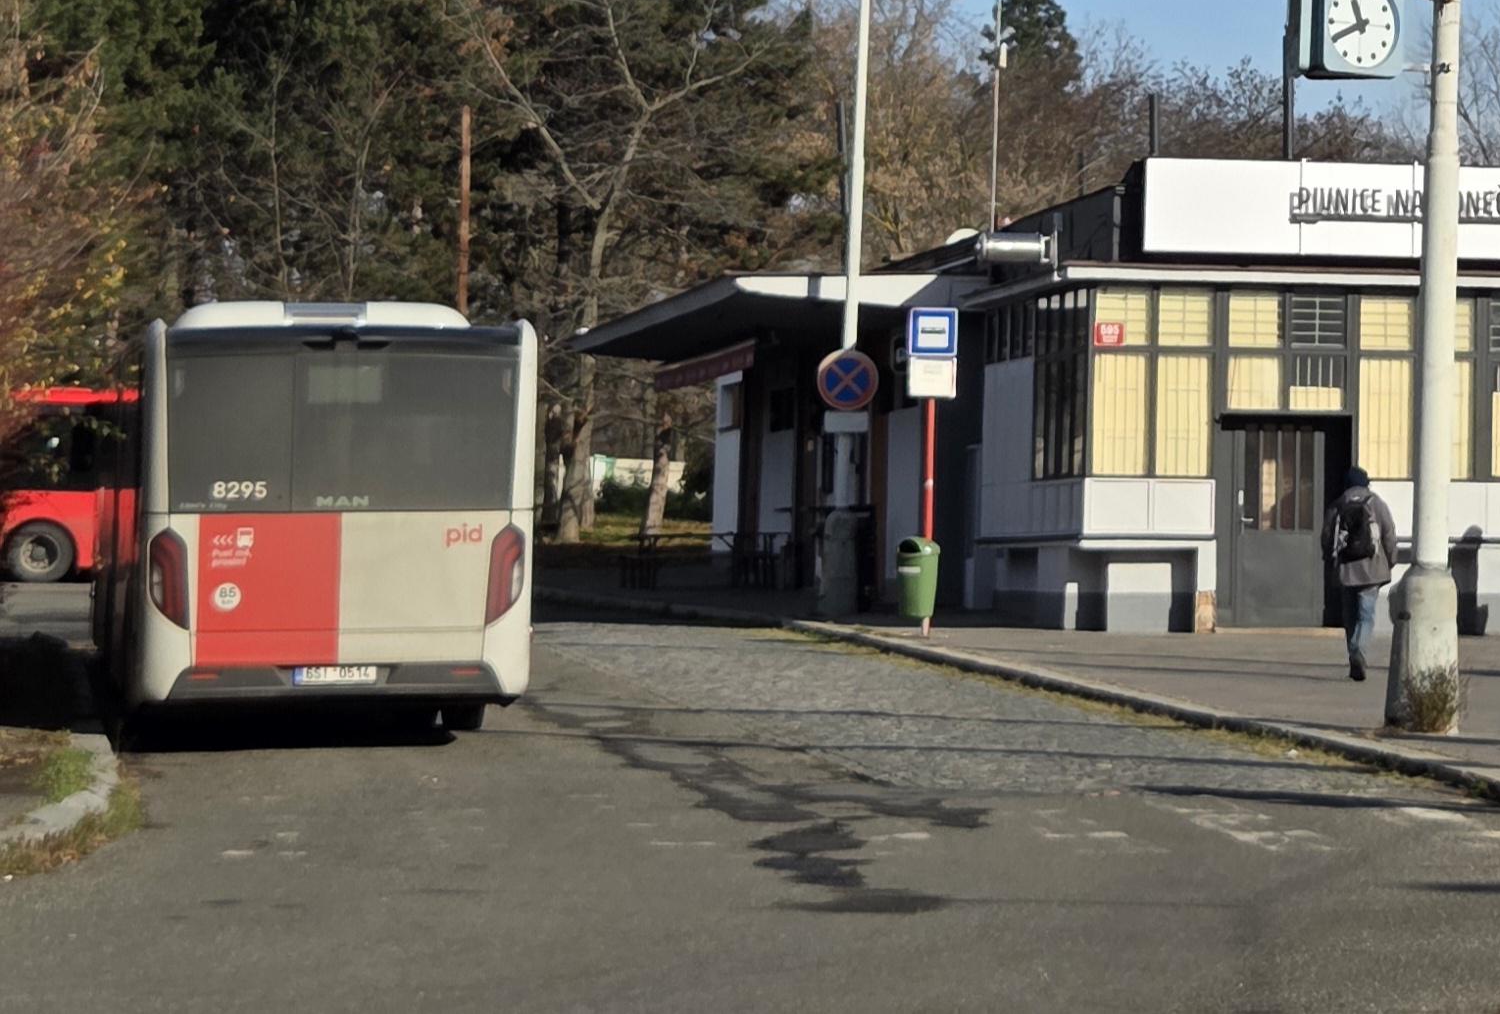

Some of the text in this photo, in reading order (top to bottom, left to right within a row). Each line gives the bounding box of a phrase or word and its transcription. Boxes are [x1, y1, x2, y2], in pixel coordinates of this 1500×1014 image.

[212, 481, 268, 499] 8295
[316, 496, 369, 507] MAN
[446, 522, 483, 548] pid
[219, 587, 237, 598] 85
